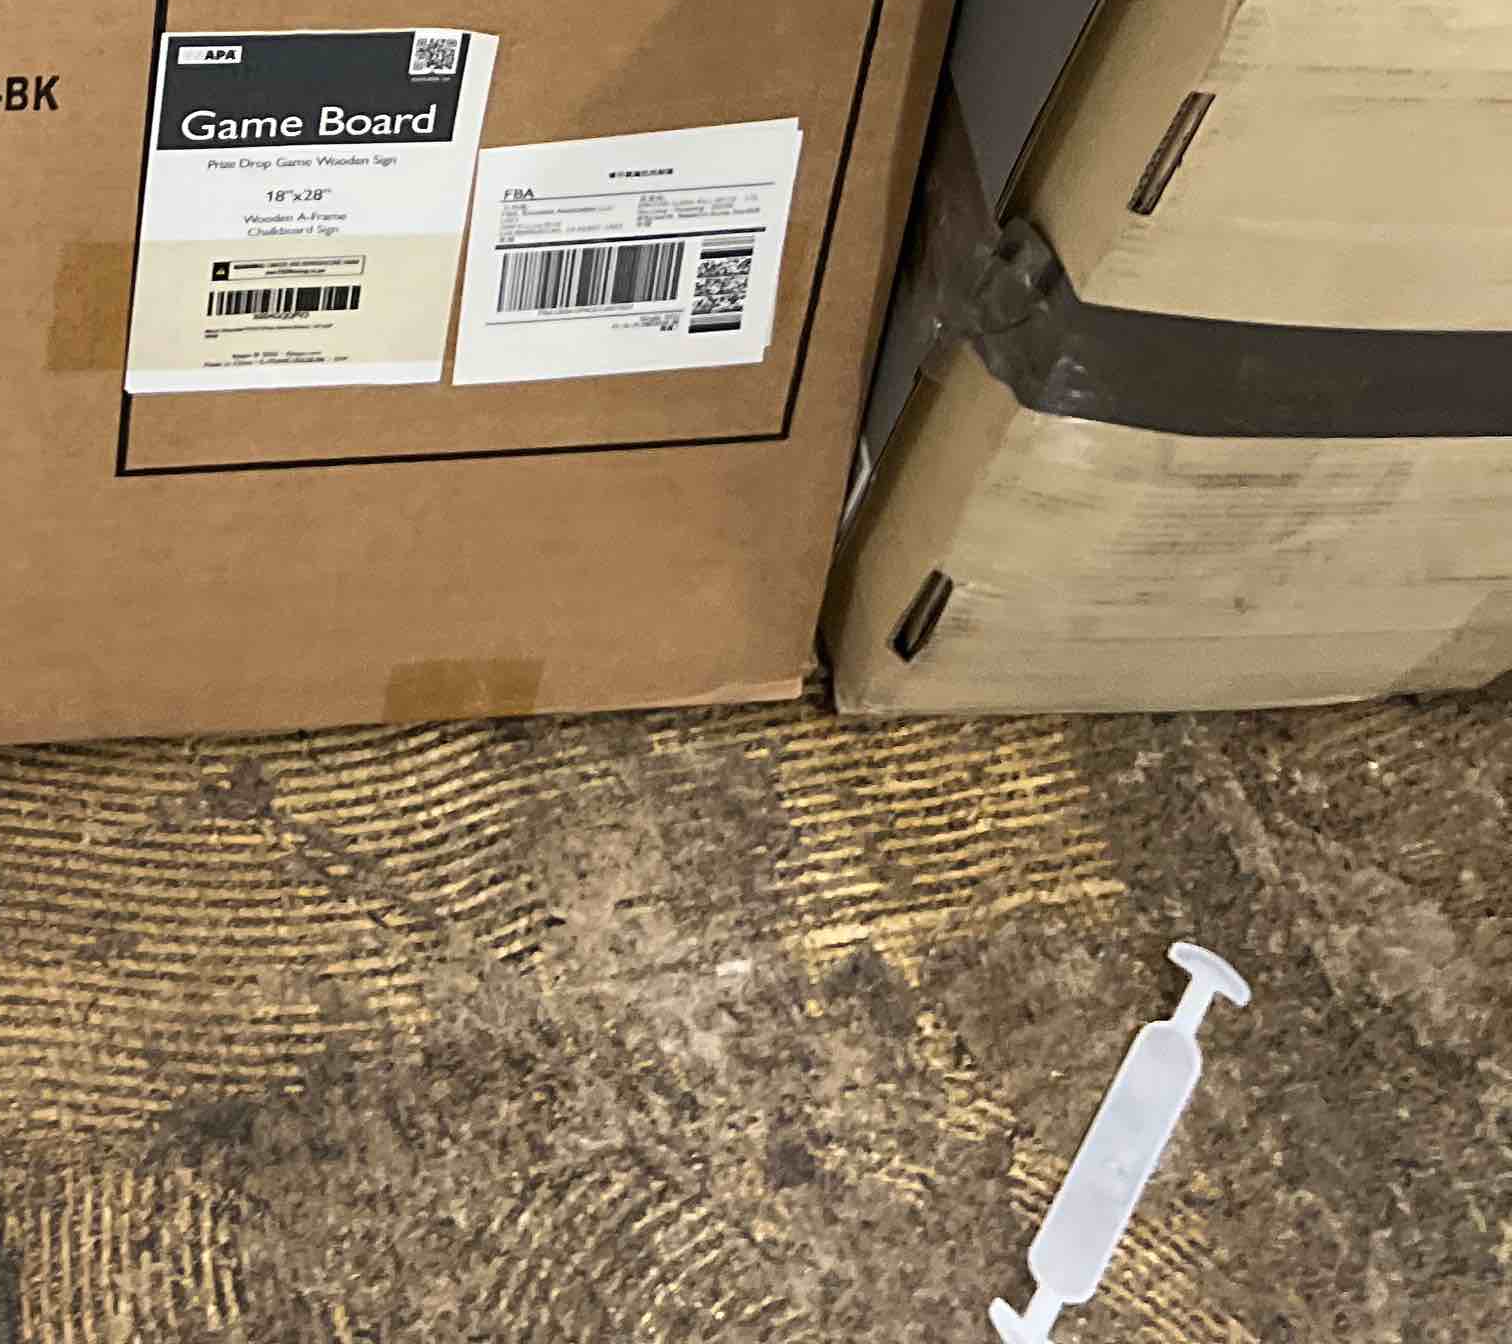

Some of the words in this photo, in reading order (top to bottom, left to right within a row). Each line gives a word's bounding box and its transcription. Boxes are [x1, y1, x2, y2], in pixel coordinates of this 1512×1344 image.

[180, 109, 303, 141] Game
[318, 104, 437, 137] Board
[503, 188, 536, 200] FBA
